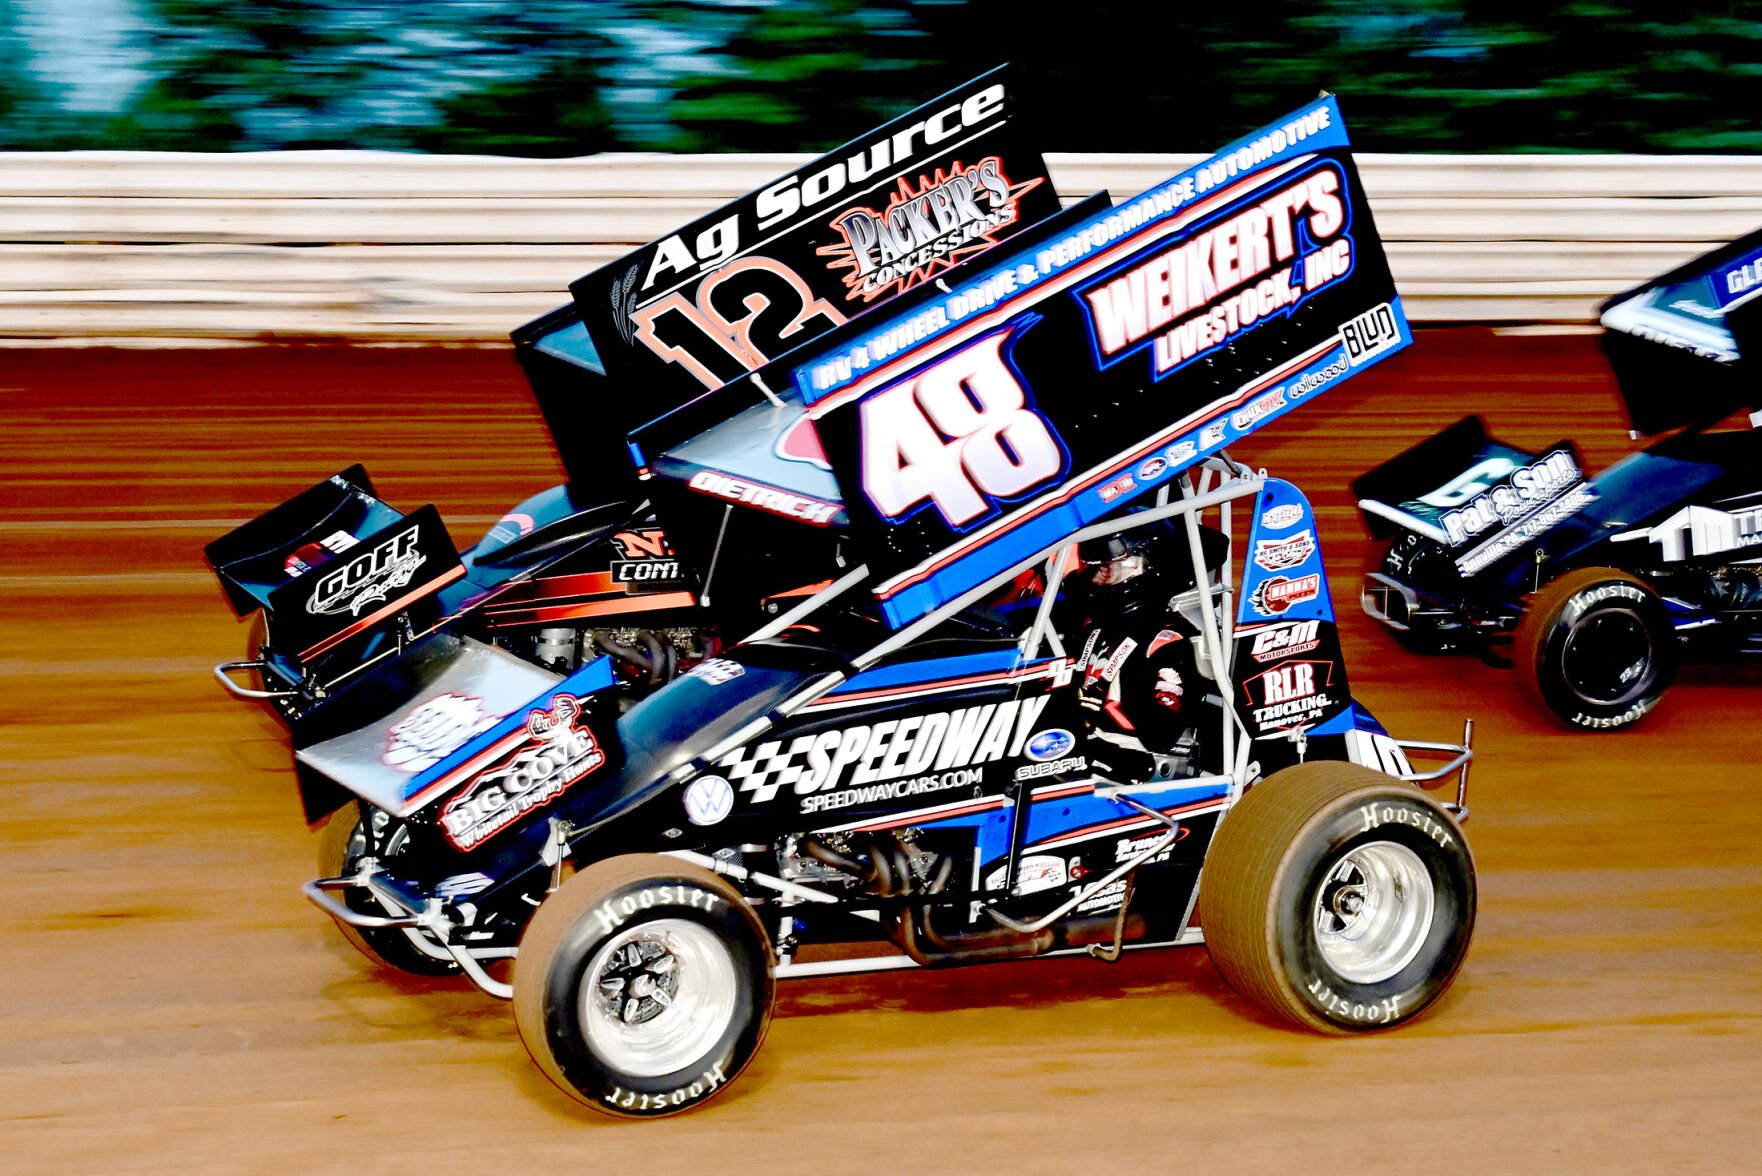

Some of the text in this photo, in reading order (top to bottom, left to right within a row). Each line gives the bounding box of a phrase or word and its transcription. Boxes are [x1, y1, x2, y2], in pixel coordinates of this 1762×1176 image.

[641, 84, 1004, 291] Ag Source
[840, 160, 1009, 277] PACKER'S
[815, 105, 1331, 389] RV 4 WHEEL DRIVE & PERFORMANCE AUTOMOTIVE
[863, 204, 1016, 292] CONCESSIONS
[1088, 170, 1344, 354] WEIKERT'S
[1156, 239, 1350, 371] LIVESTOCK, INC
[1288, 355, 1347, 398] wilwood
[860, 327, 1062, 526] 48
[689, 471, 838, 523] DIETRICH
[1443, 452, 1575, 543] Pat & Son
[315, 524, 419, 606] GOFF
[1569, 580, 1646, 617] Hoosier
[1105, 642, 1131, 677] SIMPSON
[1252, 620, 1320, 655] C&M
[1259, 641, 1315, 662] MOTORSPORTS
[1253, 693, 1333, 723] TRUCKING
[1263, 664, 1316, 705] RLR
[1572, 700, 1647, 728] Hoosier
[793, 694, 1051, 796] SPEEDWAY
[1016, 756, 1088, 782] SUBARU
[448, 785, 506, 835] BIG
[503, 729, 595, 794] COVE
[458, 752, 602, 848] Whitetail Trophy Hunts
[800, 767, 983, 814] SPEEDWAYCARS.COM
[1359, 802, 1453, 848] Hoosier
[594, 884, 719, 935] Hoosier
[1308, 979, 1403, 1024] Hoosier
[606, 1061, 727, 1109] Hoosier
